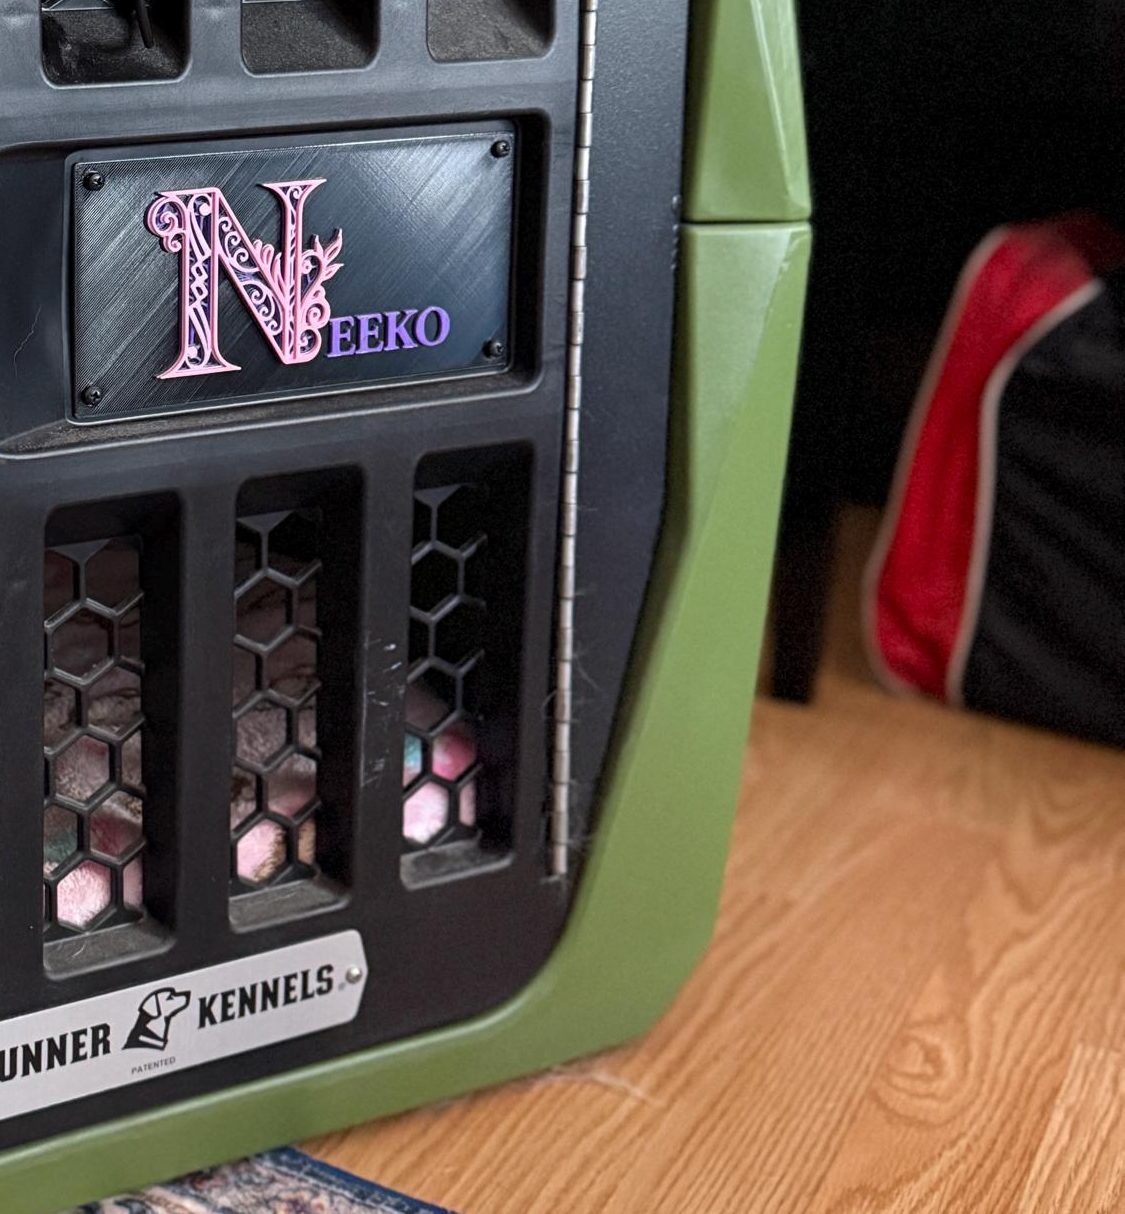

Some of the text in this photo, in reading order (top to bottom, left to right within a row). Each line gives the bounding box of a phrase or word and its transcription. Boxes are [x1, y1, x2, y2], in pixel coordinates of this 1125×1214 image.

[145, 178, 451, 379] NEEKO
[197, 964, 335, 1029] KENNELS
[131, 1057, 176, 1075] PATENTED
